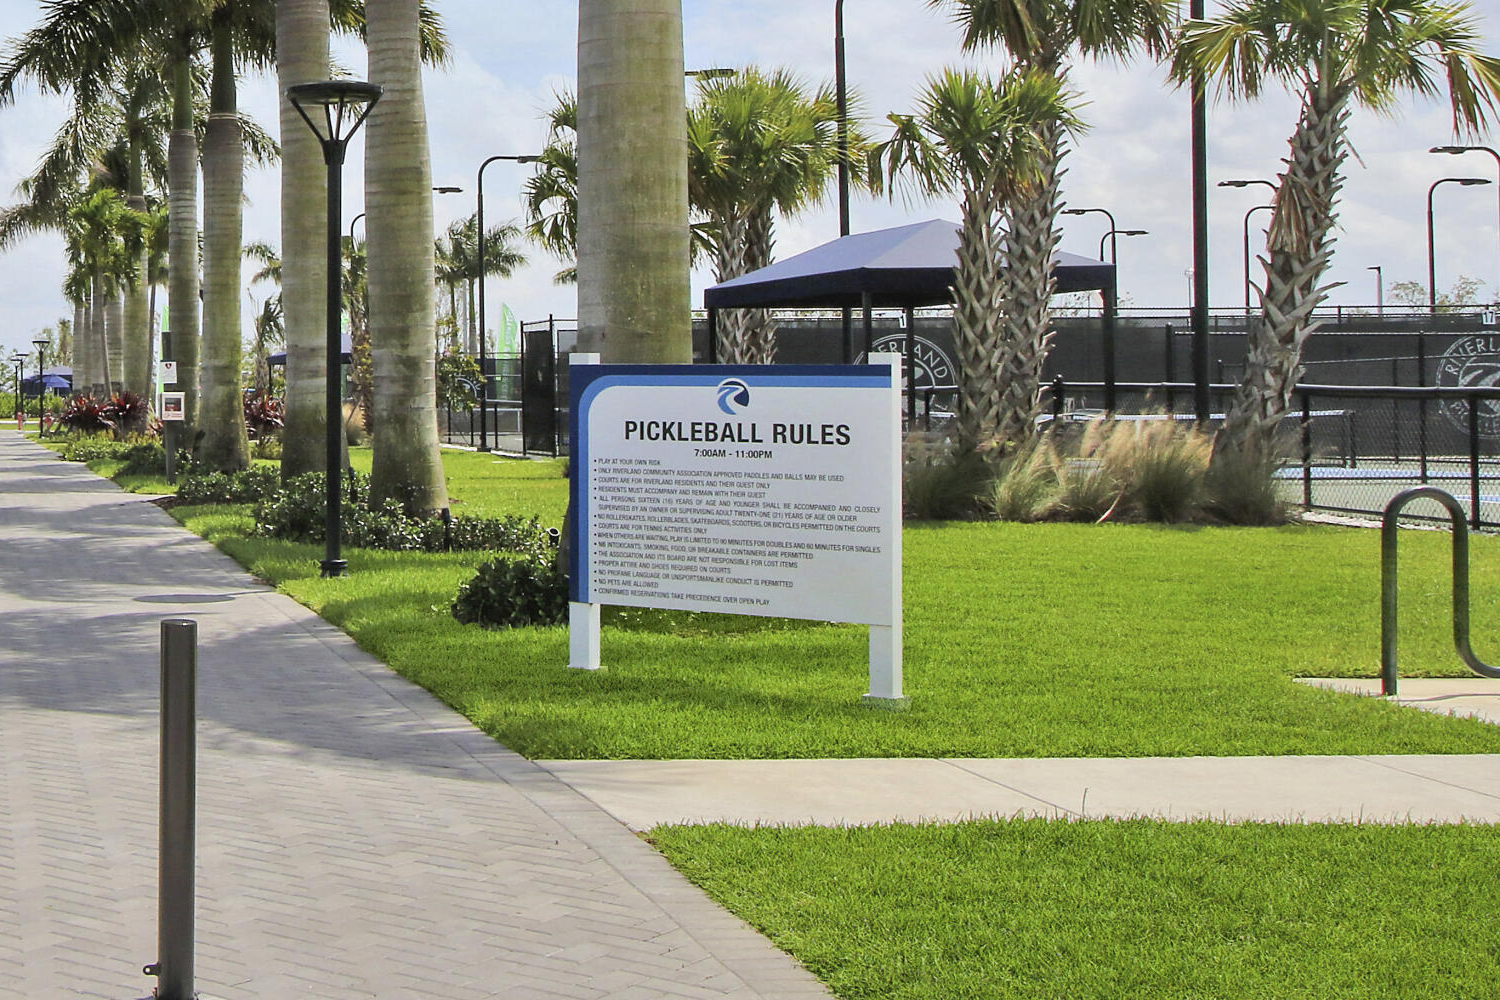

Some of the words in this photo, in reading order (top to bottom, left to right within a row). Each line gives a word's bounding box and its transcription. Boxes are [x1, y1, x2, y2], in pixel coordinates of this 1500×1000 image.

[1483, 311, 1495, 323] 17
[624, 421, 763, 443] PICKLEBALL
[772, 423, 850, 446] RULES
[694, 448, 726, 458] 7:00AM
[735, 450, 773, 459] 11:00PM
[597, 457, 610, 465] PLAY
[619, 458, 633, 466] YOUR
[634, 458, 647, 466] OWN
[648, 458, 661, 466] RISK
[598, 466, 611, 474] ONLY
[612, 467, 641, 475] RIVERLAND
[642, 468, 675, 476] COMMUNITY
[676, 469, 712, 478] ASSOCIATION
[713, 470, 742, 478] APPROVED
[743, 471, 769, 479] PADDLES
[770, 471, 783, 480] AND
[784, 472, 803, 480] BALLS
[804, 472, 817, 481] MAY
[827, 473, 844, 482] USED
[597, 476, 619, 484] COURTS
[619, 476, 630, 484] ARE
[631, 477, 642, 485] FOR
[643, 477, 673, 486] RIVERLAND
[674, 478, 704, 487] RESIDENTS
[705, 479, 717, 487] AND
[718, 479, 734, 488] THEIR
[735, 480, 754, 488] GUEST
[755, 481, 770, 489] ONLY
[597, 485, 627, 494] RESIDENTS
[627, 486, 643, 494] MUST
[644, 487, 677, 495] ACCOMPANY
[678, 488, 690, 496] AND
[691, 488, 713, 497] REMAIN
[714, 489, 728, 497] WITH
[729, 490, 745, 498] THEIR
[746, 490, 766, 499] GUEST
[599, 494, 609, 502] ALL
[610, 495, 635, 503] PERSONS
[637, 496, 660, 504] SIXTEEN
[675, 497, 693, 506] YEARS
[704, 498, 716, 507] AGE
[718, 499, 731, 507] AND
[732, 499, 759, 508] YOUNGER
[762, 500, 780, 509] SHALL
[793, 502, 836, 511] ACCOMPANIED
[838, 503, 851, 512] AND
[853, 504, 880, 513] CLOSELY
[598, 503, 630, 512] SUPERVISED
[648, 505, 668, 514] OWNER
[678, 507, 714, 516] SUPERVISING
[715, 508, 733, 517] ADULT
[733, 509, 771, 518] TWENTY-ONE
[784, 511, 803, 520] YEARS
[813, 512, 825, 521] AGE
[836, 513, 857, 522] OLDER
[597, 522, 619, 530] COURTS
[619, 523, 630, 531] ARE
[631, 523, 642, 531] FOR
[643, 524, 662, 532] TENNIS
[663, 525, 692, 534] ACTIVITIES
[693, 526, 707, 534] ONLY
[771, 520, 800, 529] BICYCLES
[800, 521, 834, 531] PERMITTED
[843, 523, 855, 532] THE
[855, 524, 880, 533] COURTS
[597, 531, 613, 539] WHEN
[613, 532, 634, 540] OTHERS
[633, 533, 645, 541] ARE
[668, 534, 683, 543] PLAY
[689, 536, 711, 544] LIMITED
[727, 537, 753, 547] MINUTES
[753, 539, 765, 547] FOR
[765, 539, 792, 549] DOUBLES
[792, 541, 805, 549] AND
[814, 542, 841, 551] MINUTES
[841, 543, 854, 552] FOR
[854, 544, 881, 553] SINGLES
[597, 549, 608, 558] THE
[608, 550, 643, 560] ASSOCIATION
[643, 552, 656, 560] AND
[656, 553, 665, 561] ITS
[666, 553, 685, 562] BOARD
[686, 554, 697, 563] ARE
[698, 555, 710, 564] NOT
[710, 556, 749, 566] RESPONSIBLE
[750, 558, 762, 567] FOR
[763, 559, 778, 568] LOST
[778, 560, 798, 569] ITEMS
[697, 545, 729, 555] BREAKABLE
[730, 547, 766, 557] CONTAINERS
[767, 549, 779, 558] ARE
[780, 550, 813, 560] PERMITTED
[598, 559, 619, 568] PROPER
[619, 560, 638, 569] ATTIRE
[638, 561, 650, 569] AND
[651, 562, 669, 571] SHOES
[670, 563, 698, 572] REQUIRED
[708, 565, 731, 574] COURTS
[607, 569, 631, 578] PROFANE
[631, 570, 660, 580] LANGUAGE
[670, 573, 724, 584] UNSPORTSMANLIKE
[725, 576, 752, 586] CONDUCT
[760, 578, 793, 588] PERMITTED
[607, 578, 620, 586] PETS
[621, 579, 632, 587] ARE
[632, 579, 659, 589] ALLOWED
[597, 586, 629, 596] CONFIRMED
[630, 589, 670, 599] RESERVATIONS
[670, 591, 684, 600] TAKE
[685, 592, 721, 603] PRECEDENCE
[722, 595, 737, 604] OVER
[738, 596, 754, 605] OPEN
[755, 597, 770, 606] PLAY
